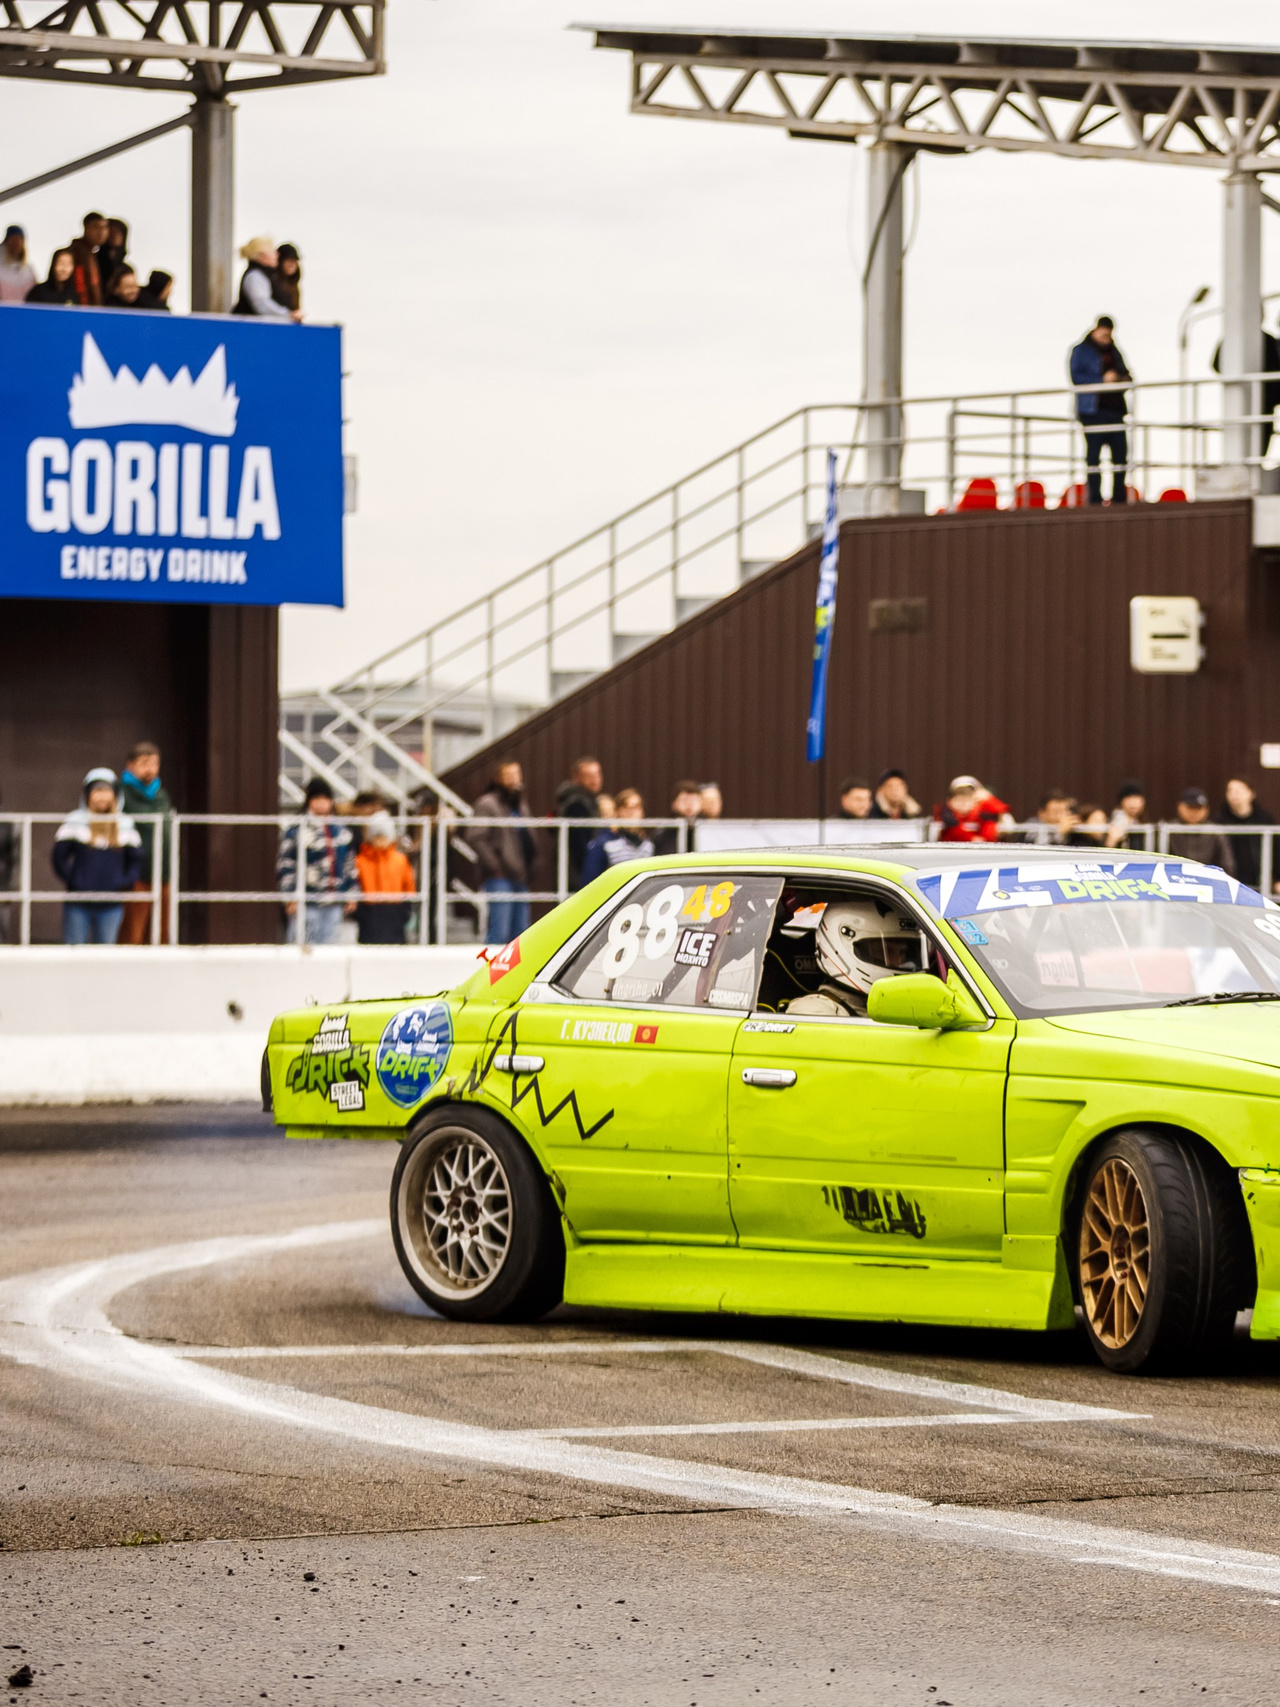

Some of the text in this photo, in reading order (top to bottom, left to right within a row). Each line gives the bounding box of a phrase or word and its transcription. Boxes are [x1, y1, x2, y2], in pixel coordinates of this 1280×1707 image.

[26, 436, 282, 540] GORILLA
[60, 545, 248, 585] ENERGY DRINK
[682, 881, 736, 921] 48
[1056, 879, 1171, 901] DRIFT
[602, 884, 685, 979] 88
[680, 931, 716, 957] ICE
[560, 1020, 634, 1044] Г. КУЗНЕЦОВ
[380, 1049, 440, 1084] DRIFT
[333, 1083, 359, 1097] STREET
[341, 1093, 361, 1107] LEGAL
